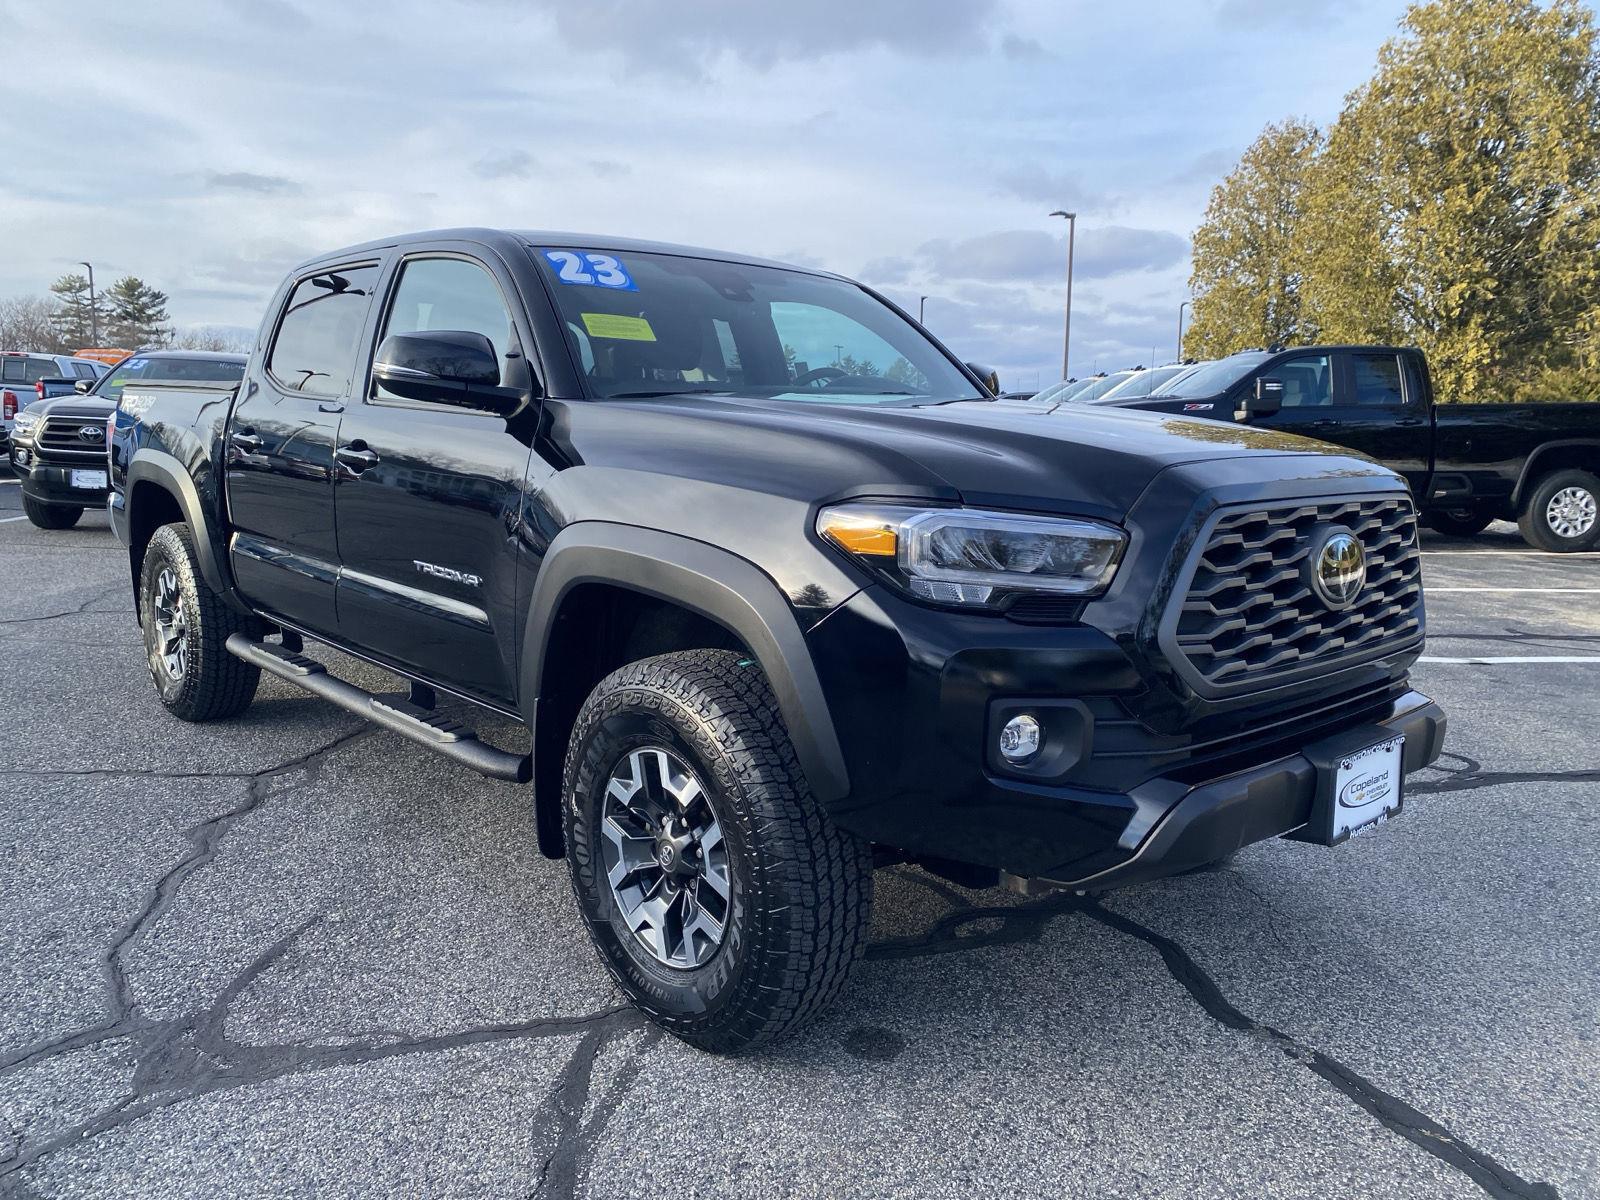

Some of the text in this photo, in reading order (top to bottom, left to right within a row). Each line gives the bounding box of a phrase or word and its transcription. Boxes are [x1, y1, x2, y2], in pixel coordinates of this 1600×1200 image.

[546, 251, 631, 287] 23
[122, 359, 149, 370] 23
[413, 559, 483, 587] TACOMA
[1350, 769, 1389, 794] Copeland
[570, 730, 609, 896] OODYEAR
[707, 855, 744, 1000] ANGLER
